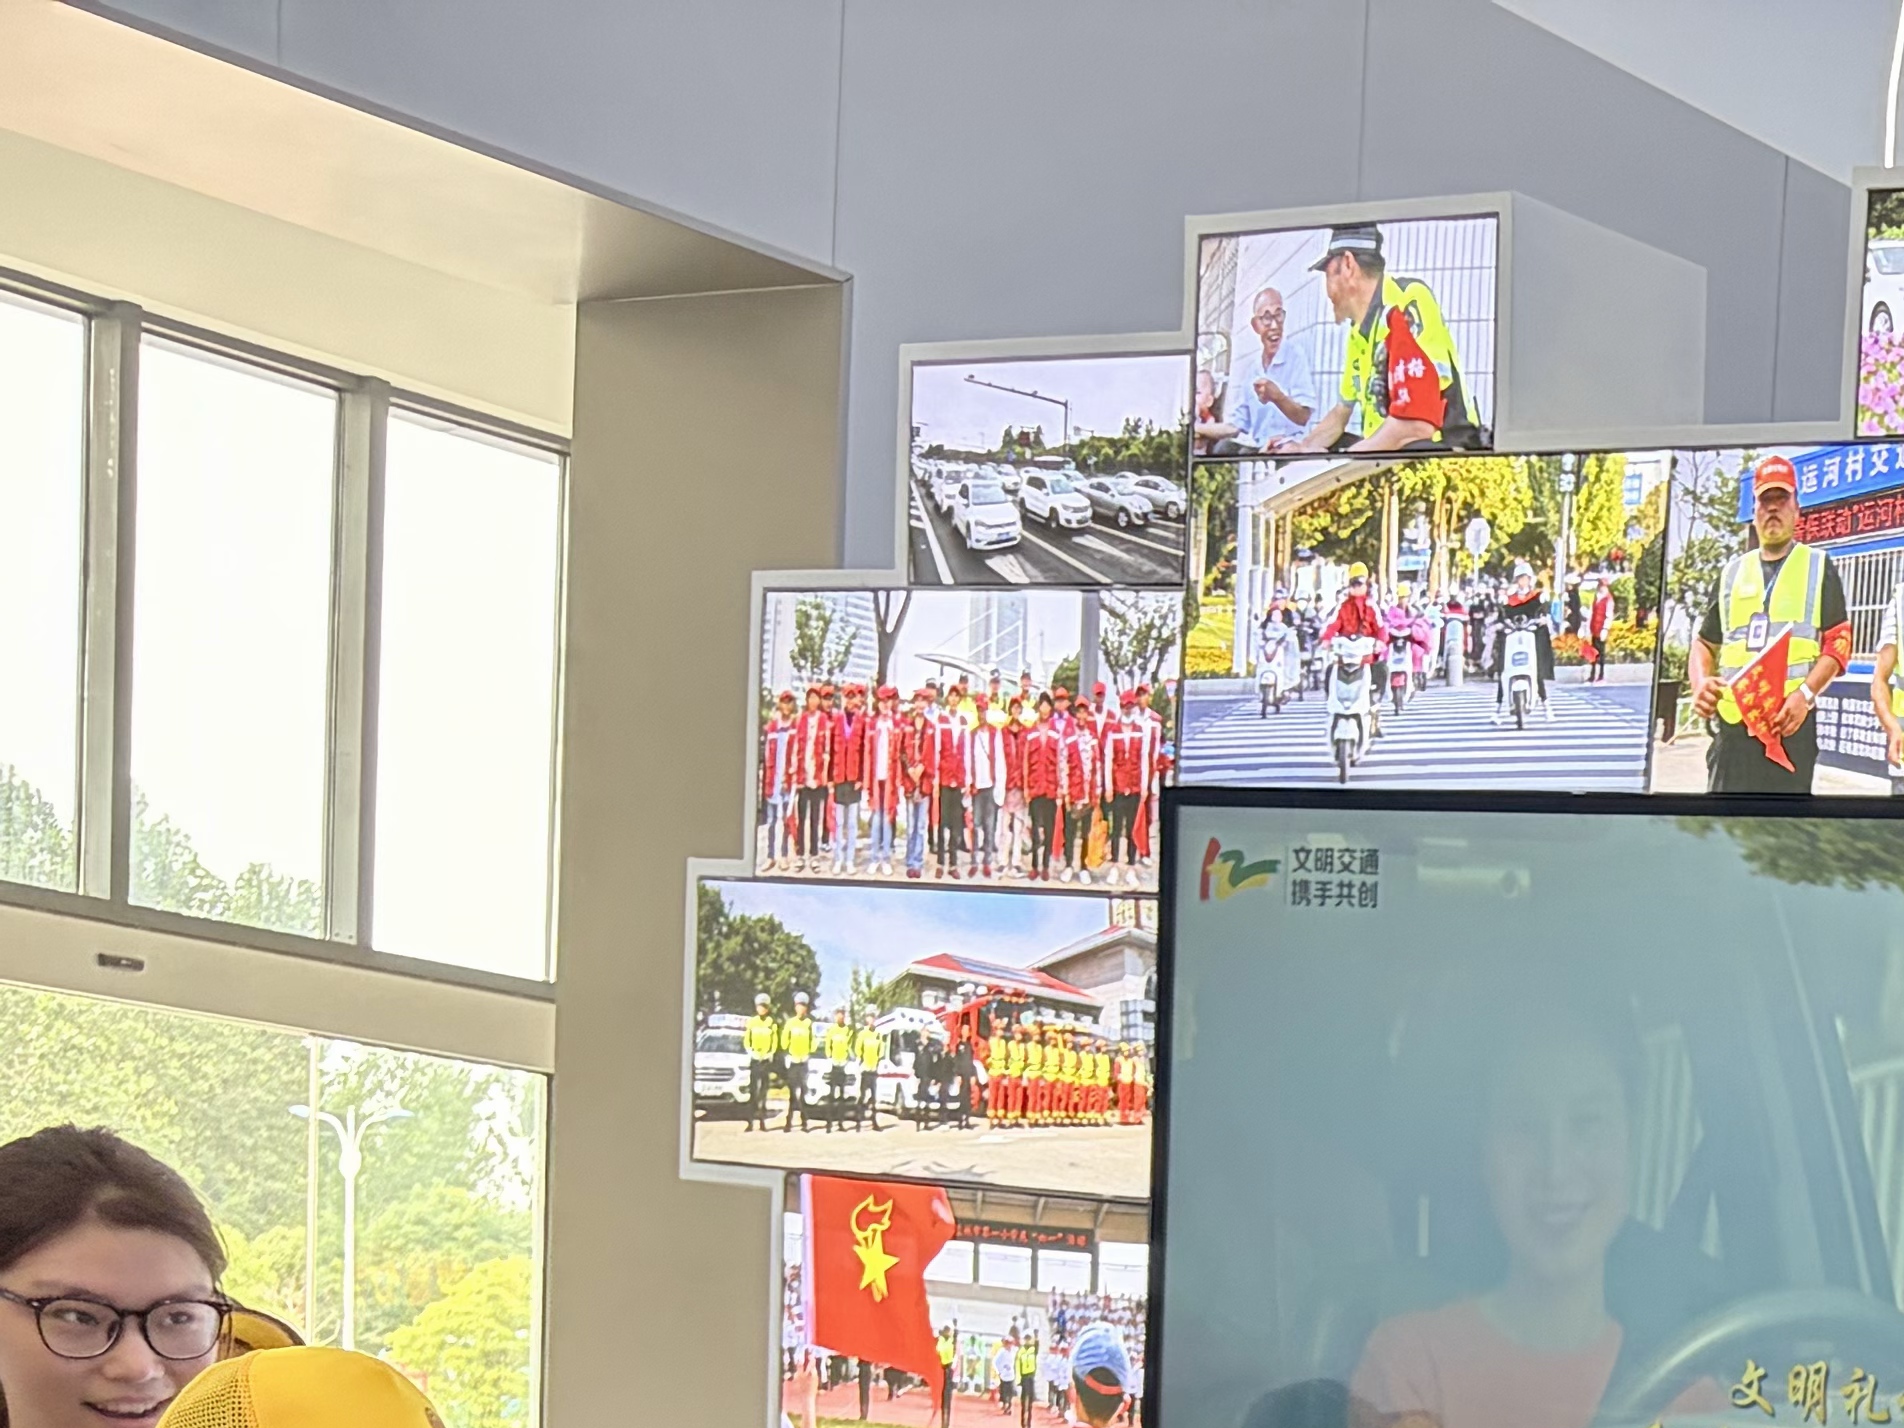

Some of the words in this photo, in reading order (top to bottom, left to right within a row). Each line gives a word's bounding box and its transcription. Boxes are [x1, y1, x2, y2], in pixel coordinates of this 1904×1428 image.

[1291, 846, 1380, 876] 文明交通
[1290, 879, 1379, 909] 携手共创
